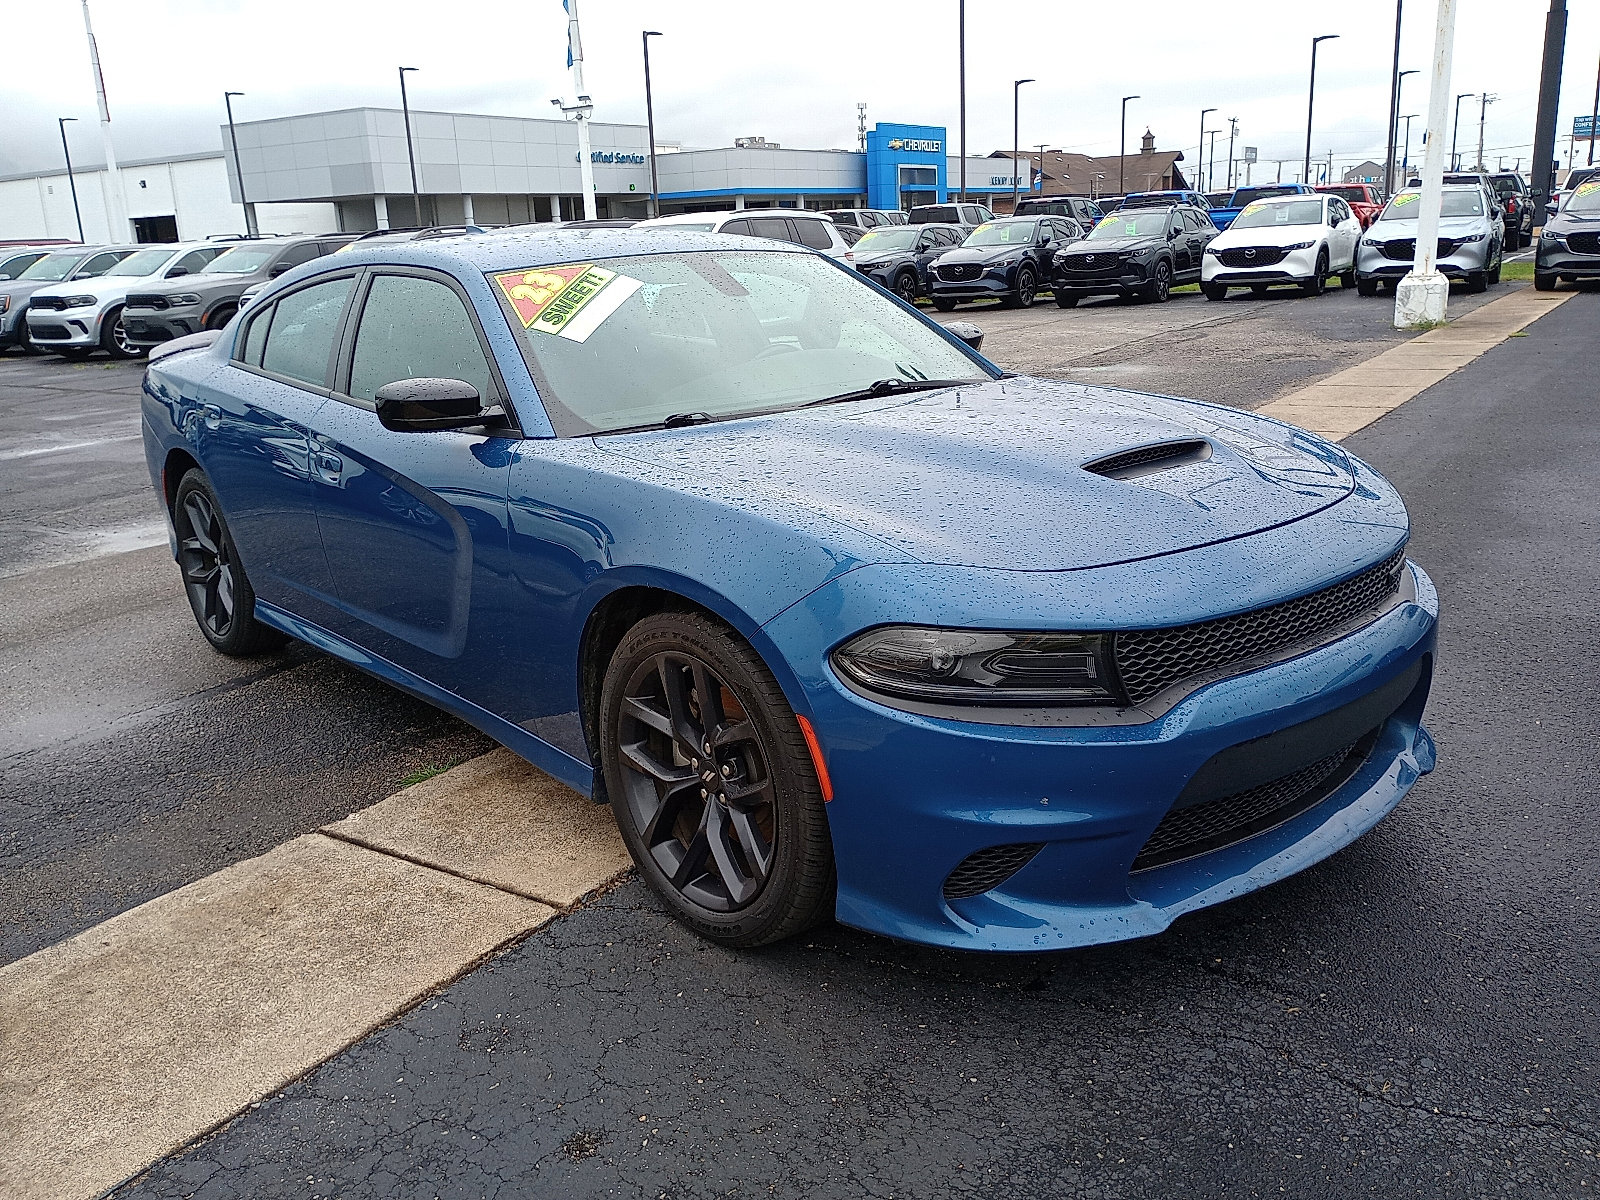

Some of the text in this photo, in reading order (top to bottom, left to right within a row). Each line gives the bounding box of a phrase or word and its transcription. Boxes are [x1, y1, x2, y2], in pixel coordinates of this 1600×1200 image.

[903, 138, 942, 152] CHEVROLET
[614, 152, 645, 164] Service
[1358, 174, 1384, 184] home
[541, 272, 605, 326] SWEET!
